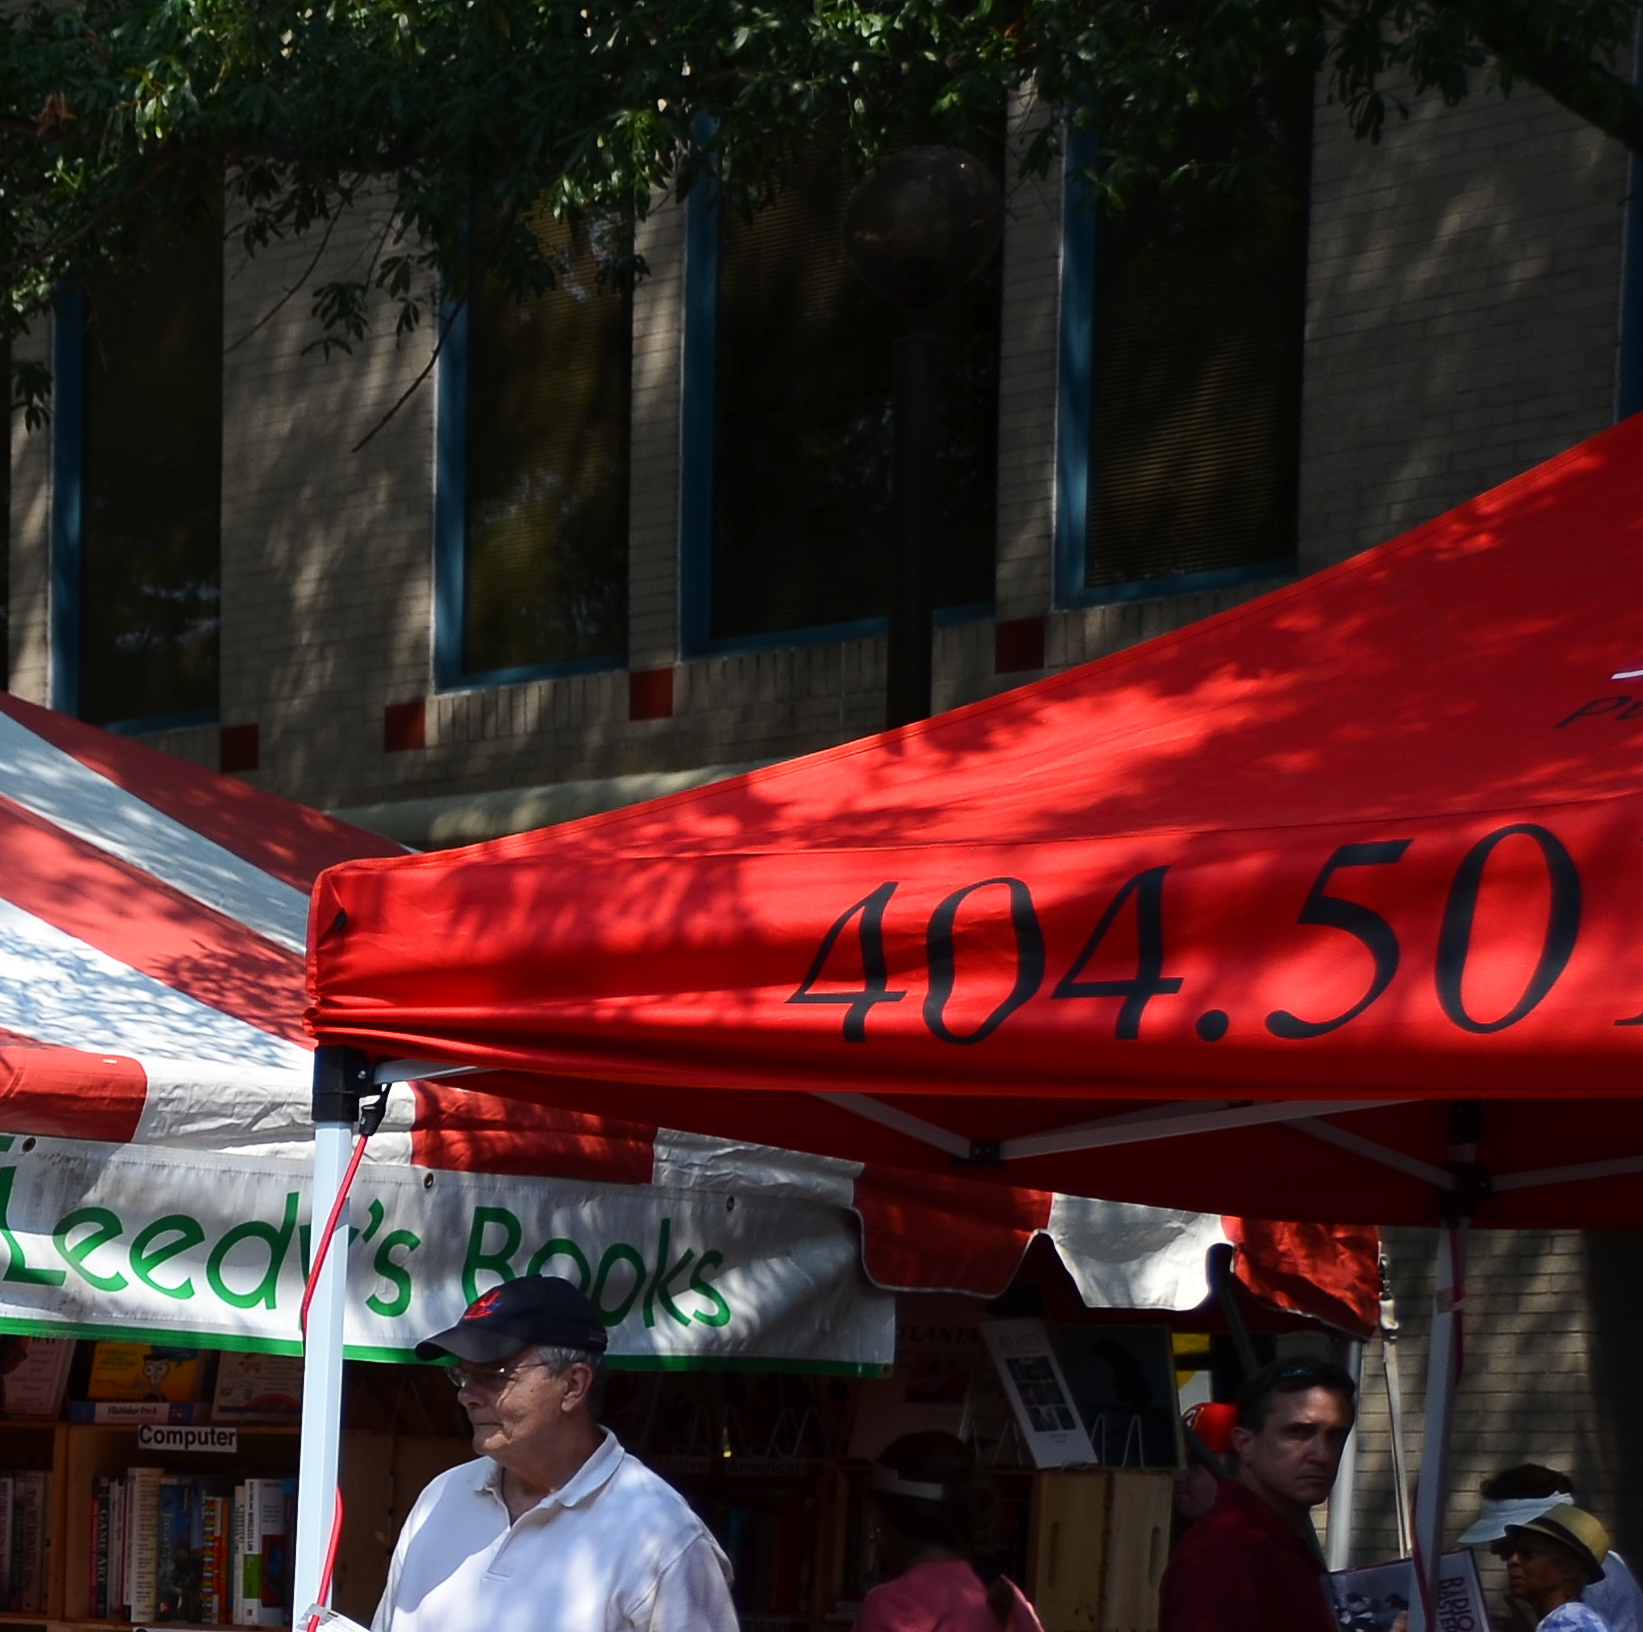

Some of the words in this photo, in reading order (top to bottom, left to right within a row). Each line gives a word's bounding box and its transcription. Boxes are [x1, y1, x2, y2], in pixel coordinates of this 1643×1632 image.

[787, 823, 1643, 1046] 404.50
[460, 1204, 733, 1329] Books
[139, 1426, 236, 1452] Computer
[98, 1509, 108, 1550] GAME
[97, 1553, 107, 1585] ART
